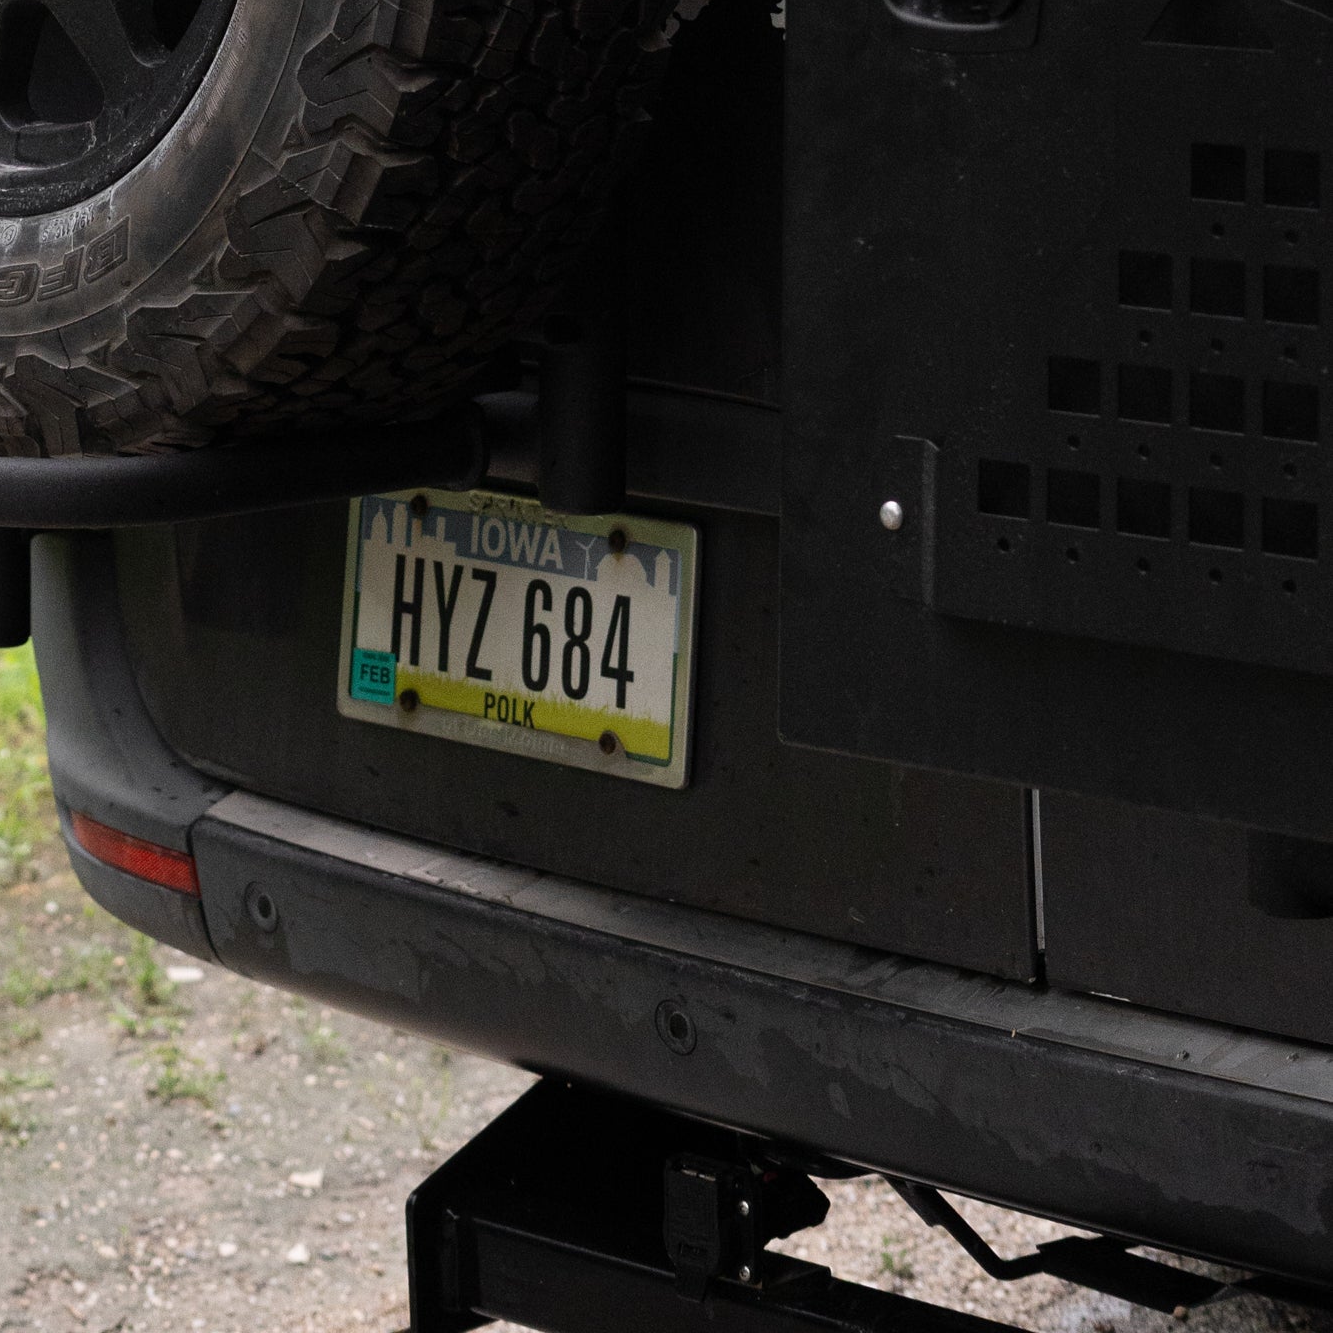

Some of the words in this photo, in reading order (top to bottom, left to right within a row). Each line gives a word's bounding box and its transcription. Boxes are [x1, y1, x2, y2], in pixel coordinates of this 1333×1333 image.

[470, 514, 565, 571] IOWA
[390, 553, 498, 683] HYZ
[521, 578, 636, 710] 684
[360, 663, 391, 685] FEB
[483, 691, 536, 730] POLK
